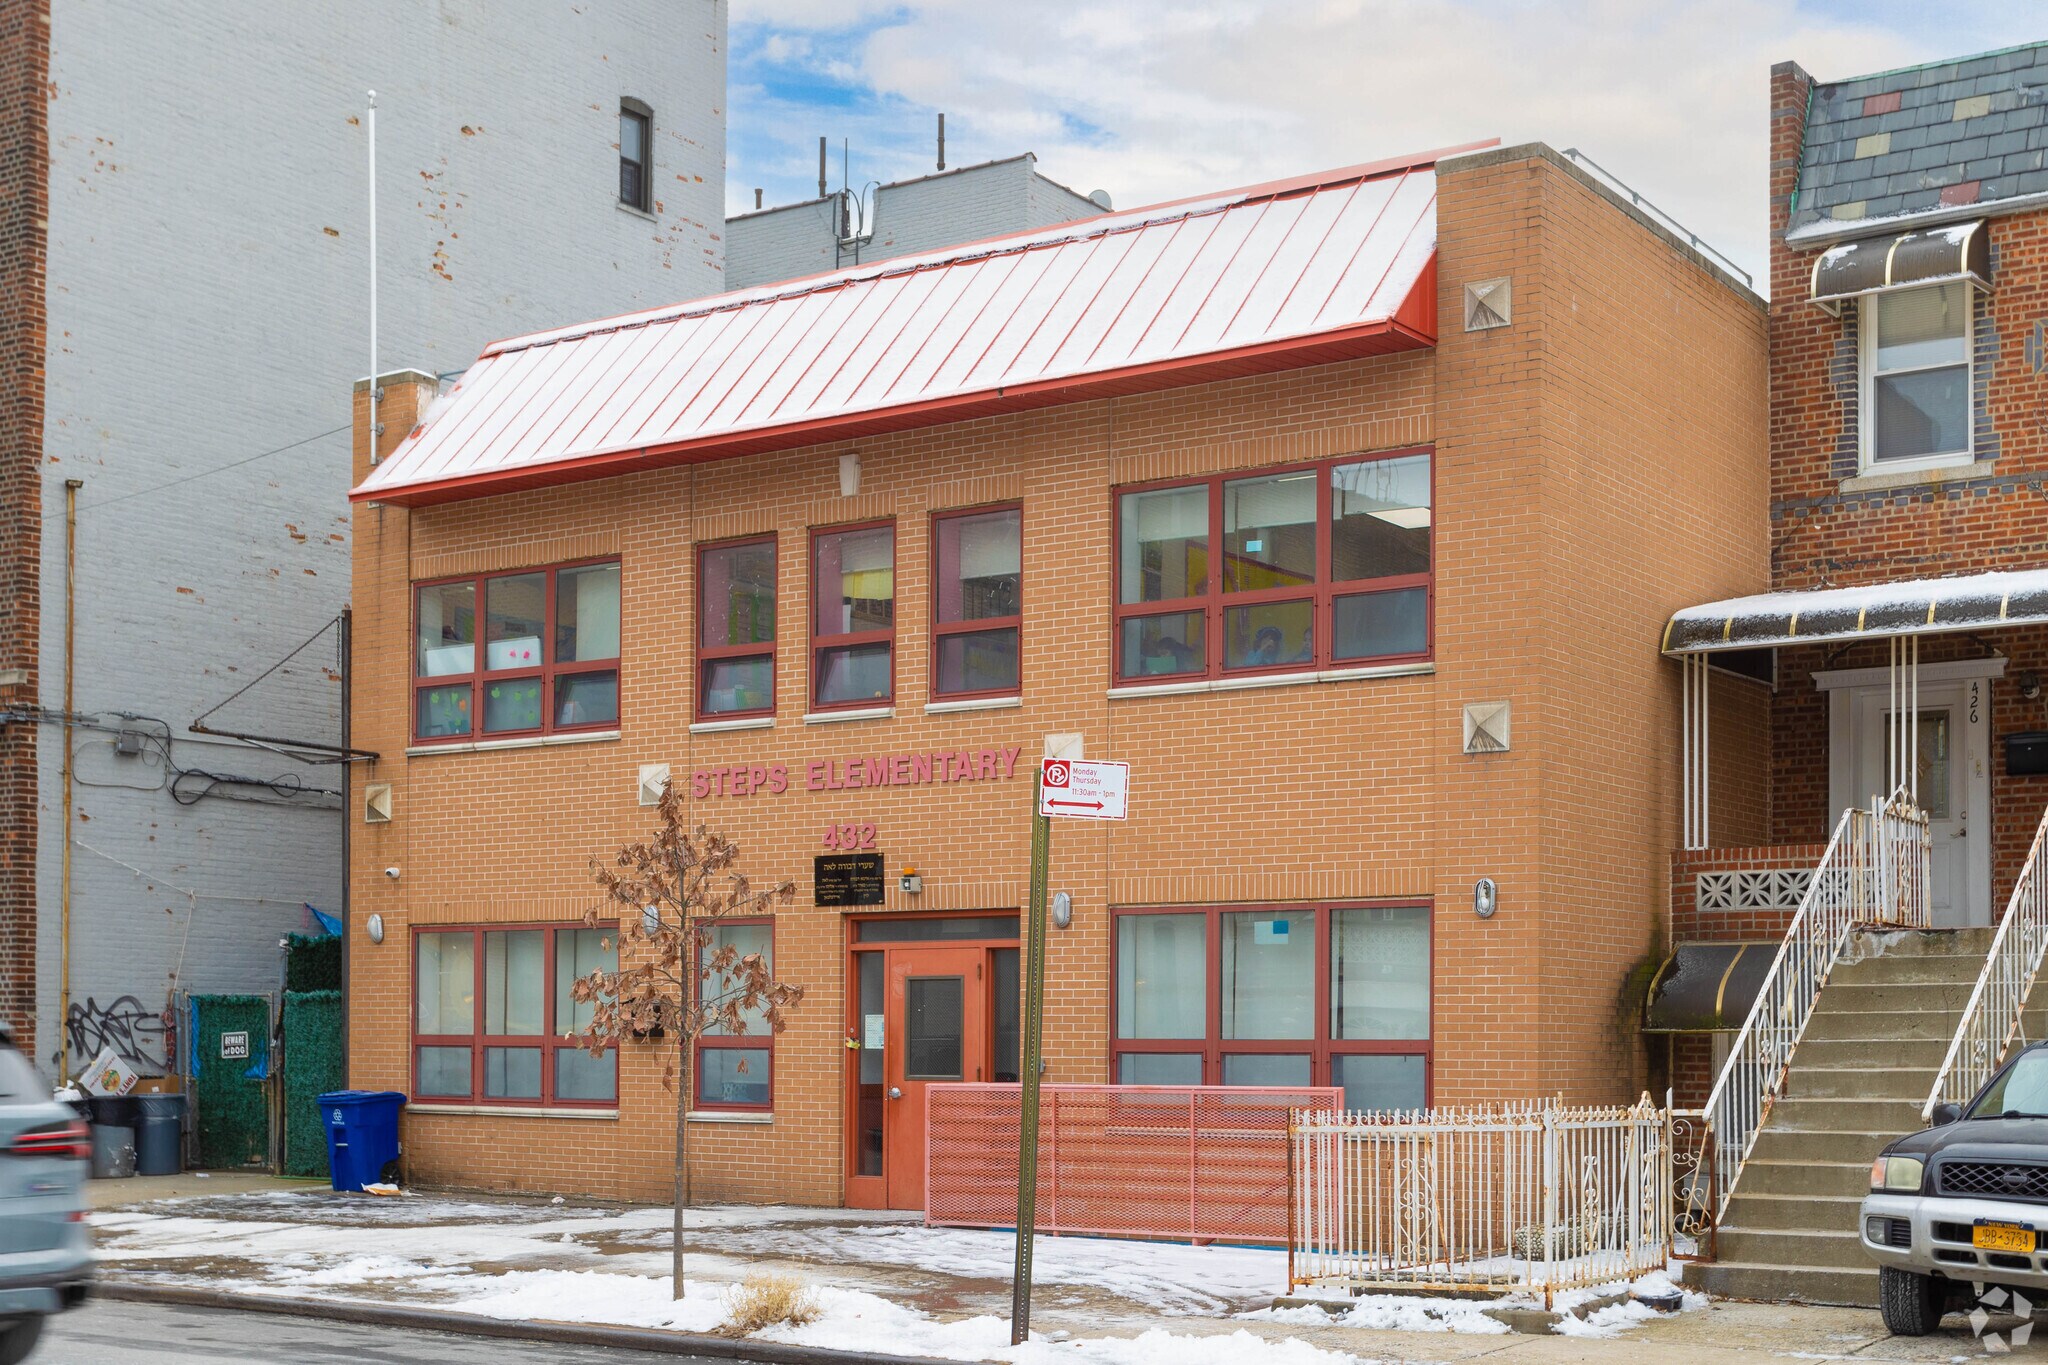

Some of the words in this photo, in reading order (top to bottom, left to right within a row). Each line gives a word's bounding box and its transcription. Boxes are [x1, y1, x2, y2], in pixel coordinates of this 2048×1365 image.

[1969, 681, 1979, 724] 426
[692, 764, 789, 799] STEPS
[806, 746, 1022, 791] ELEMENTARY
[1072, 767, 1098, 777] Monday
[1072, 776, 1102, 785] Thursday
[1071, 788, 1097, 797] 11:30am
[1103, 790, 1116, 798] 1pm
[823, 823, 877, 850] 432
[225, 1035, 245, 1045] BEWARE
[230, 1045, 245, 1055] DOG
